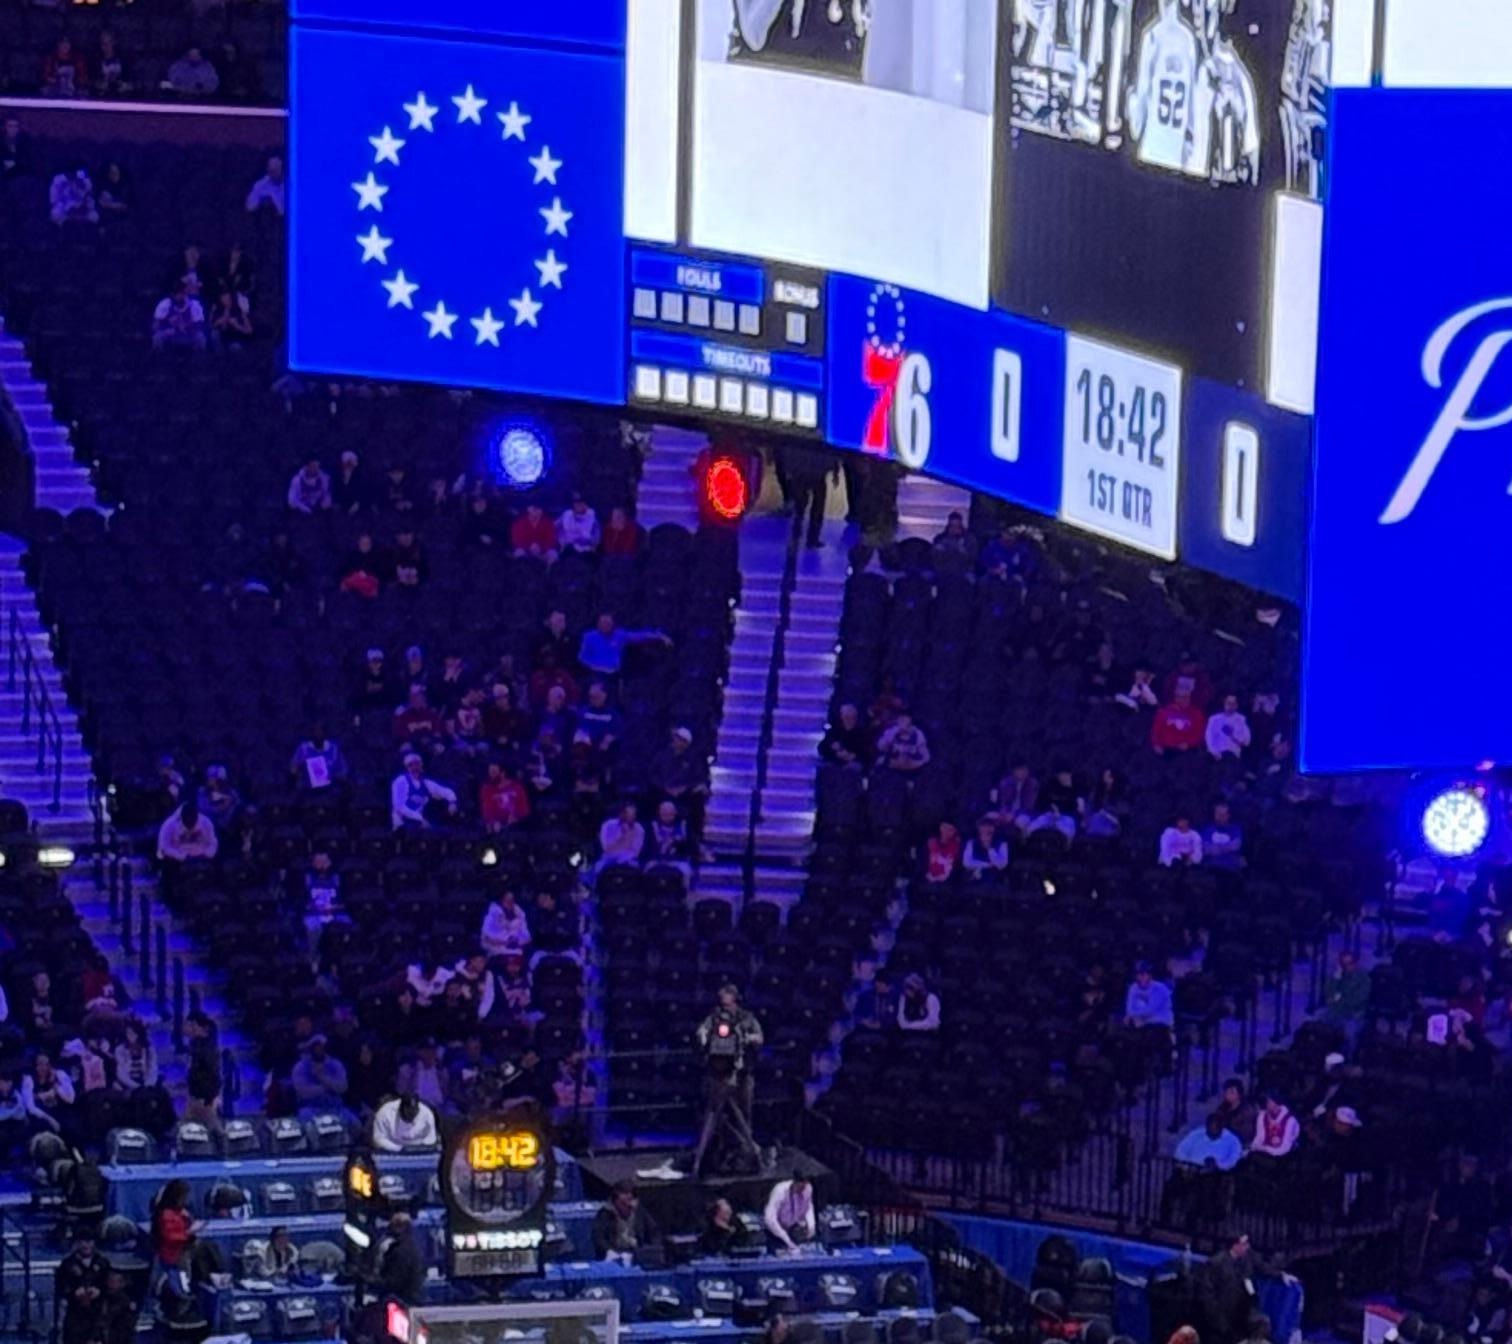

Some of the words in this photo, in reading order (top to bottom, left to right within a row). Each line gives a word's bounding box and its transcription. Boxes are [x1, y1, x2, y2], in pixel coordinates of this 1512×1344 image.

[863, 337, 932, 469] 76
[991, 347, 1022, 463] 0
[1077, 367, 1167, 469] 18:42
[1087, 468, 1117, 516] 1ST
[1122, 480, 1153, 529] QTR
[1221, 420, 1259, 547] 0
[468, 1131, 539, 1169] 18:42
